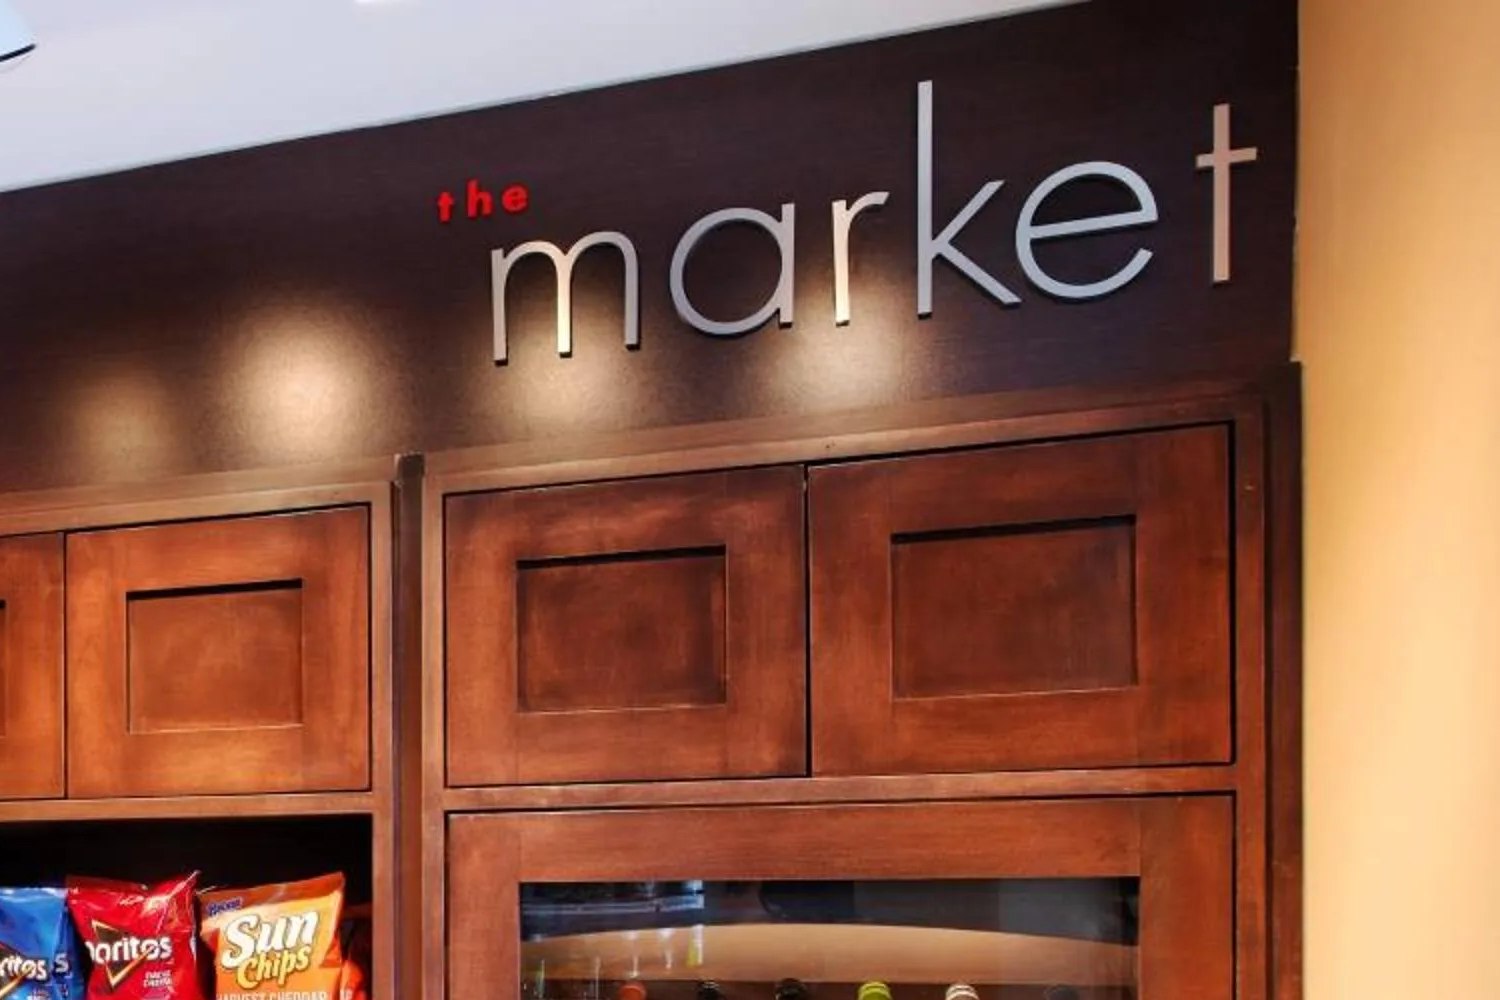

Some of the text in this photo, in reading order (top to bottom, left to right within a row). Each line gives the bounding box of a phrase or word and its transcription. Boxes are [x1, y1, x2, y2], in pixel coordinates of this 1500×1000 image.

[438, 180, 529, 222] the
[490, 79, 1258, 365] market
[221, 910, 319, 969] Sun
[236, 943, 311, 988] Chips
